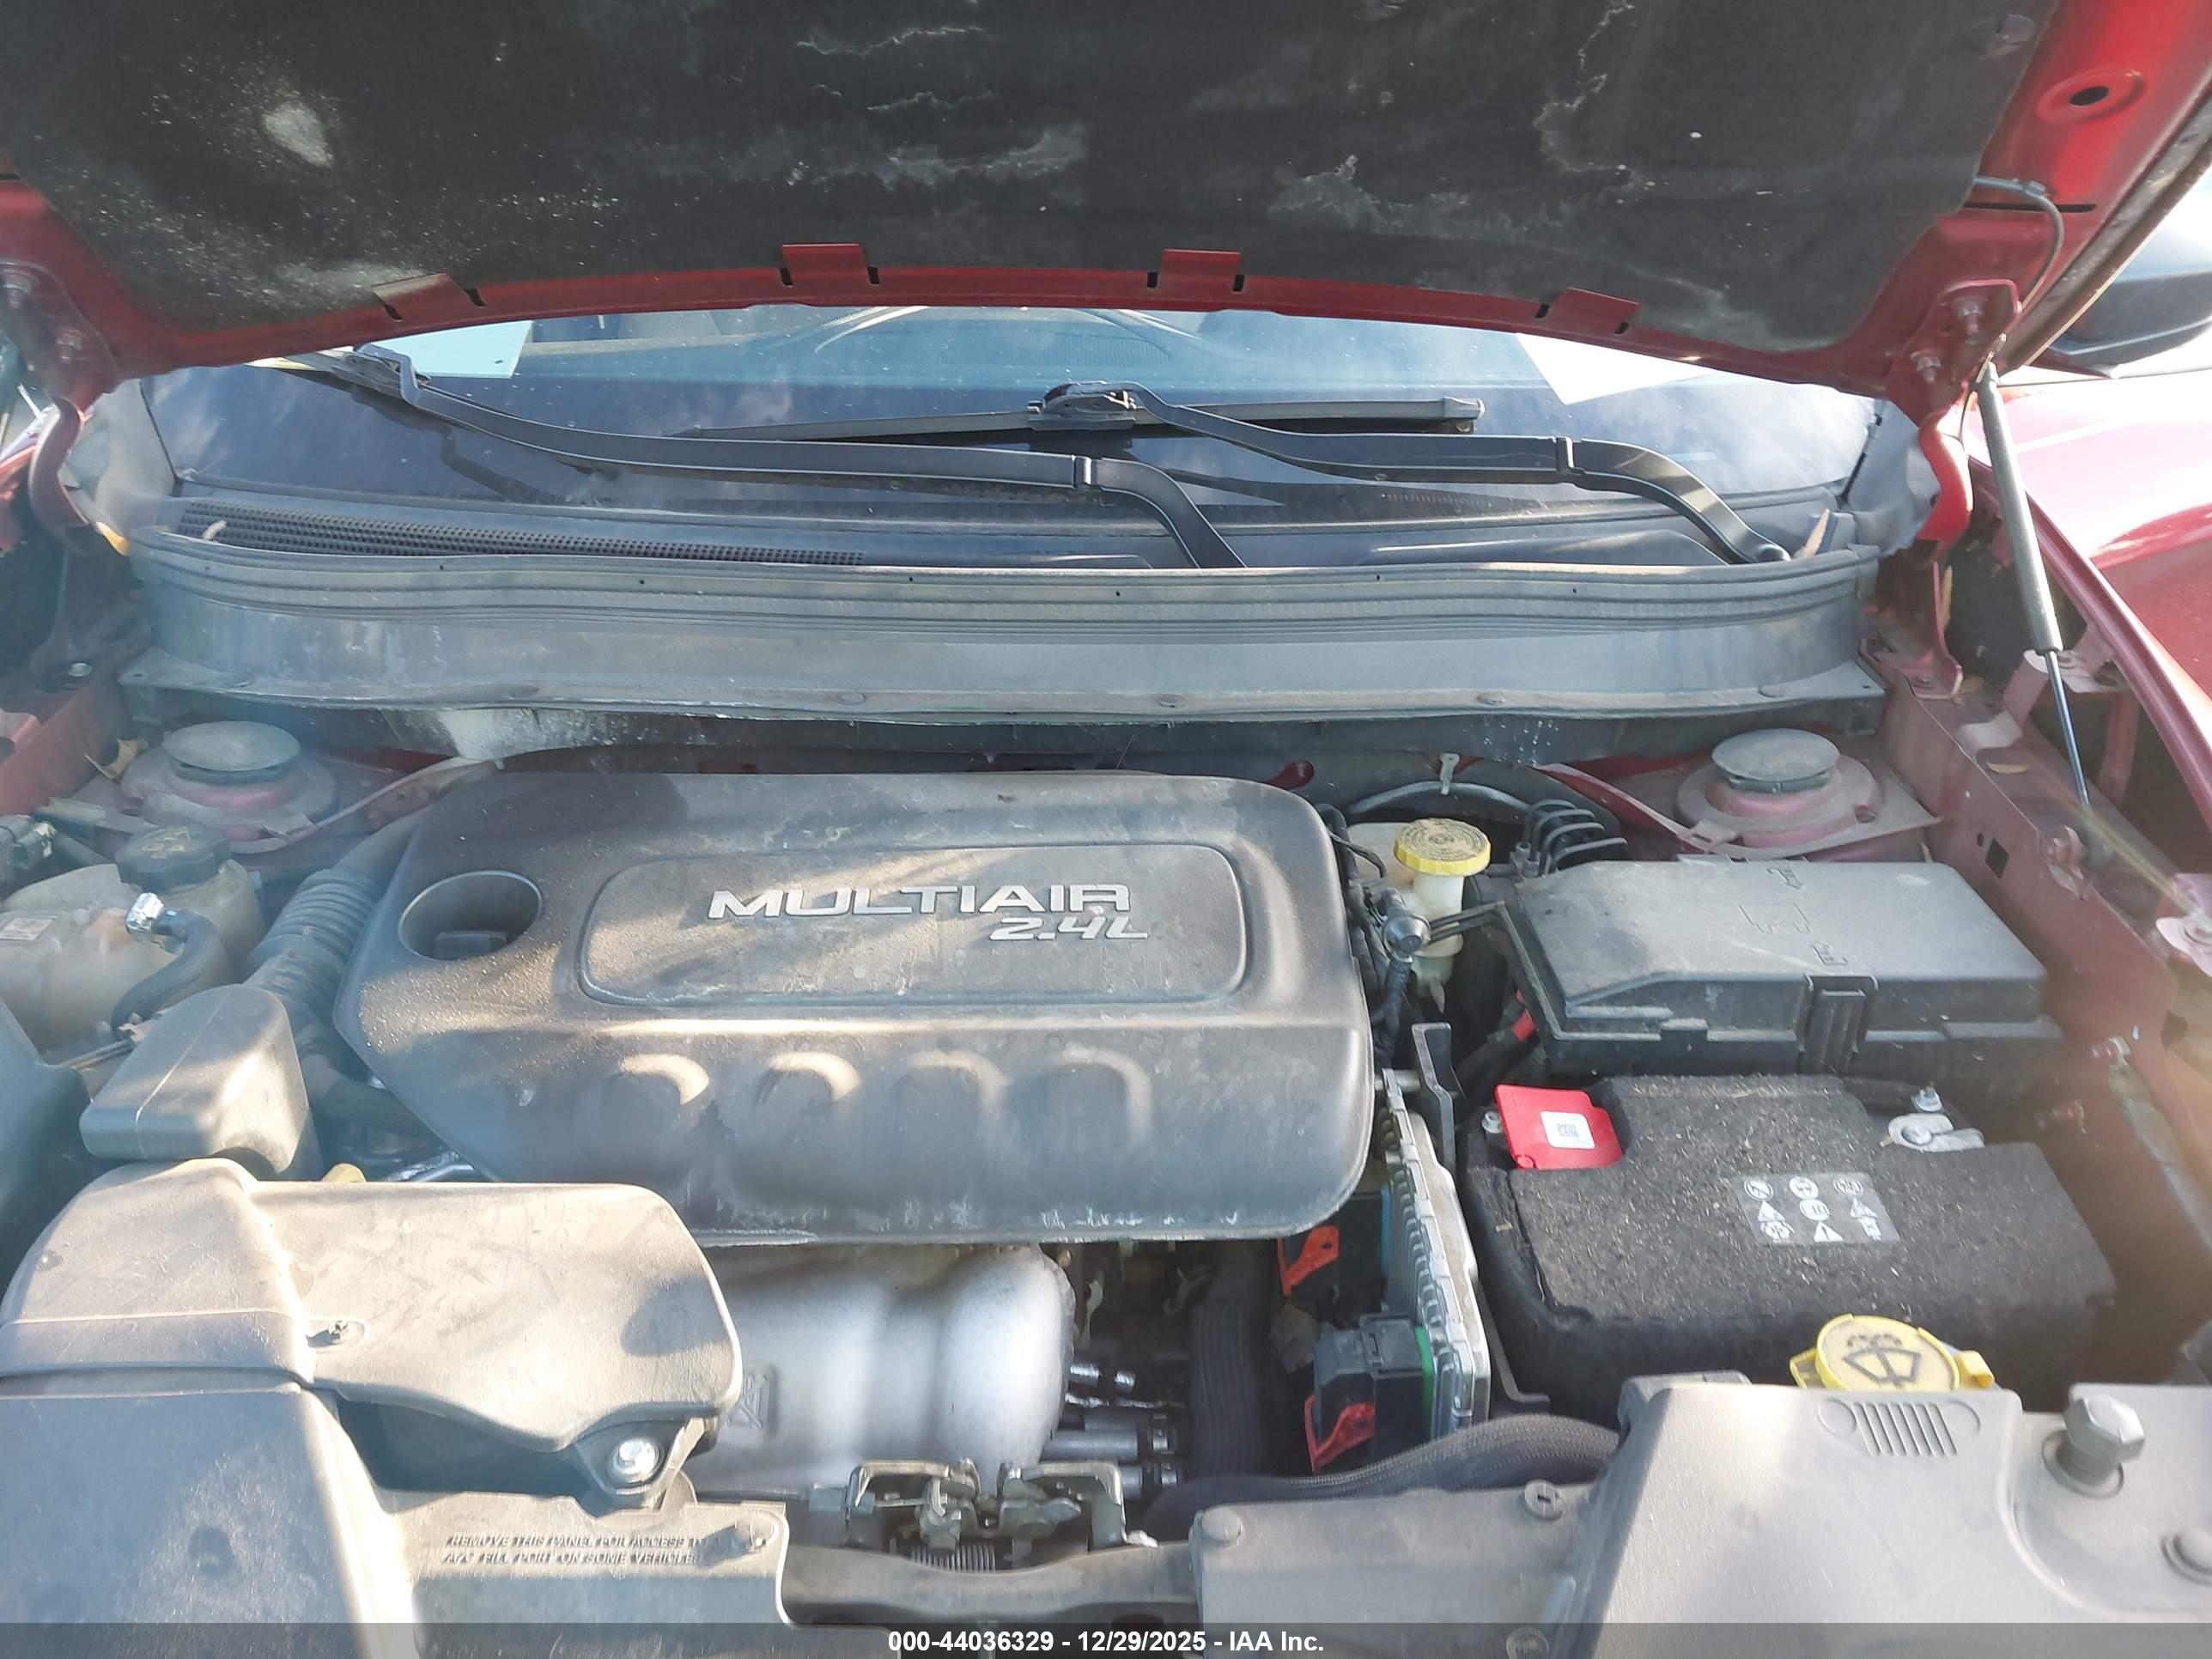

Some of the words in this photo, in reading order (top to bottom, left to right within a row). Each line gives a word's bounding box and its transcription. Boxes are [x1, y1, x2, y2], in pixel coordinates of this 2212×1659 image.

[708, 884, 1130, 919] MULTIAIR
[989, 916, 1148, 941] 2.4L
[445, 1534, 509, 1547] REMOVE
[512, 1534, 544, 1547] THIS
[547, 1534, 592, 1547] PANEL
[594, 1534, 626, 1547] FOR
[629, 1534, 685, 1547] ACCESS
[443, 1551, 475, 1564] A/C
[478, 1551, 509, 1564] FILL
[513, 1551, 552, 1565] PORT
[556, 1551, 584, 1565] ON
[585, 1551, 627, 1565] SOME
